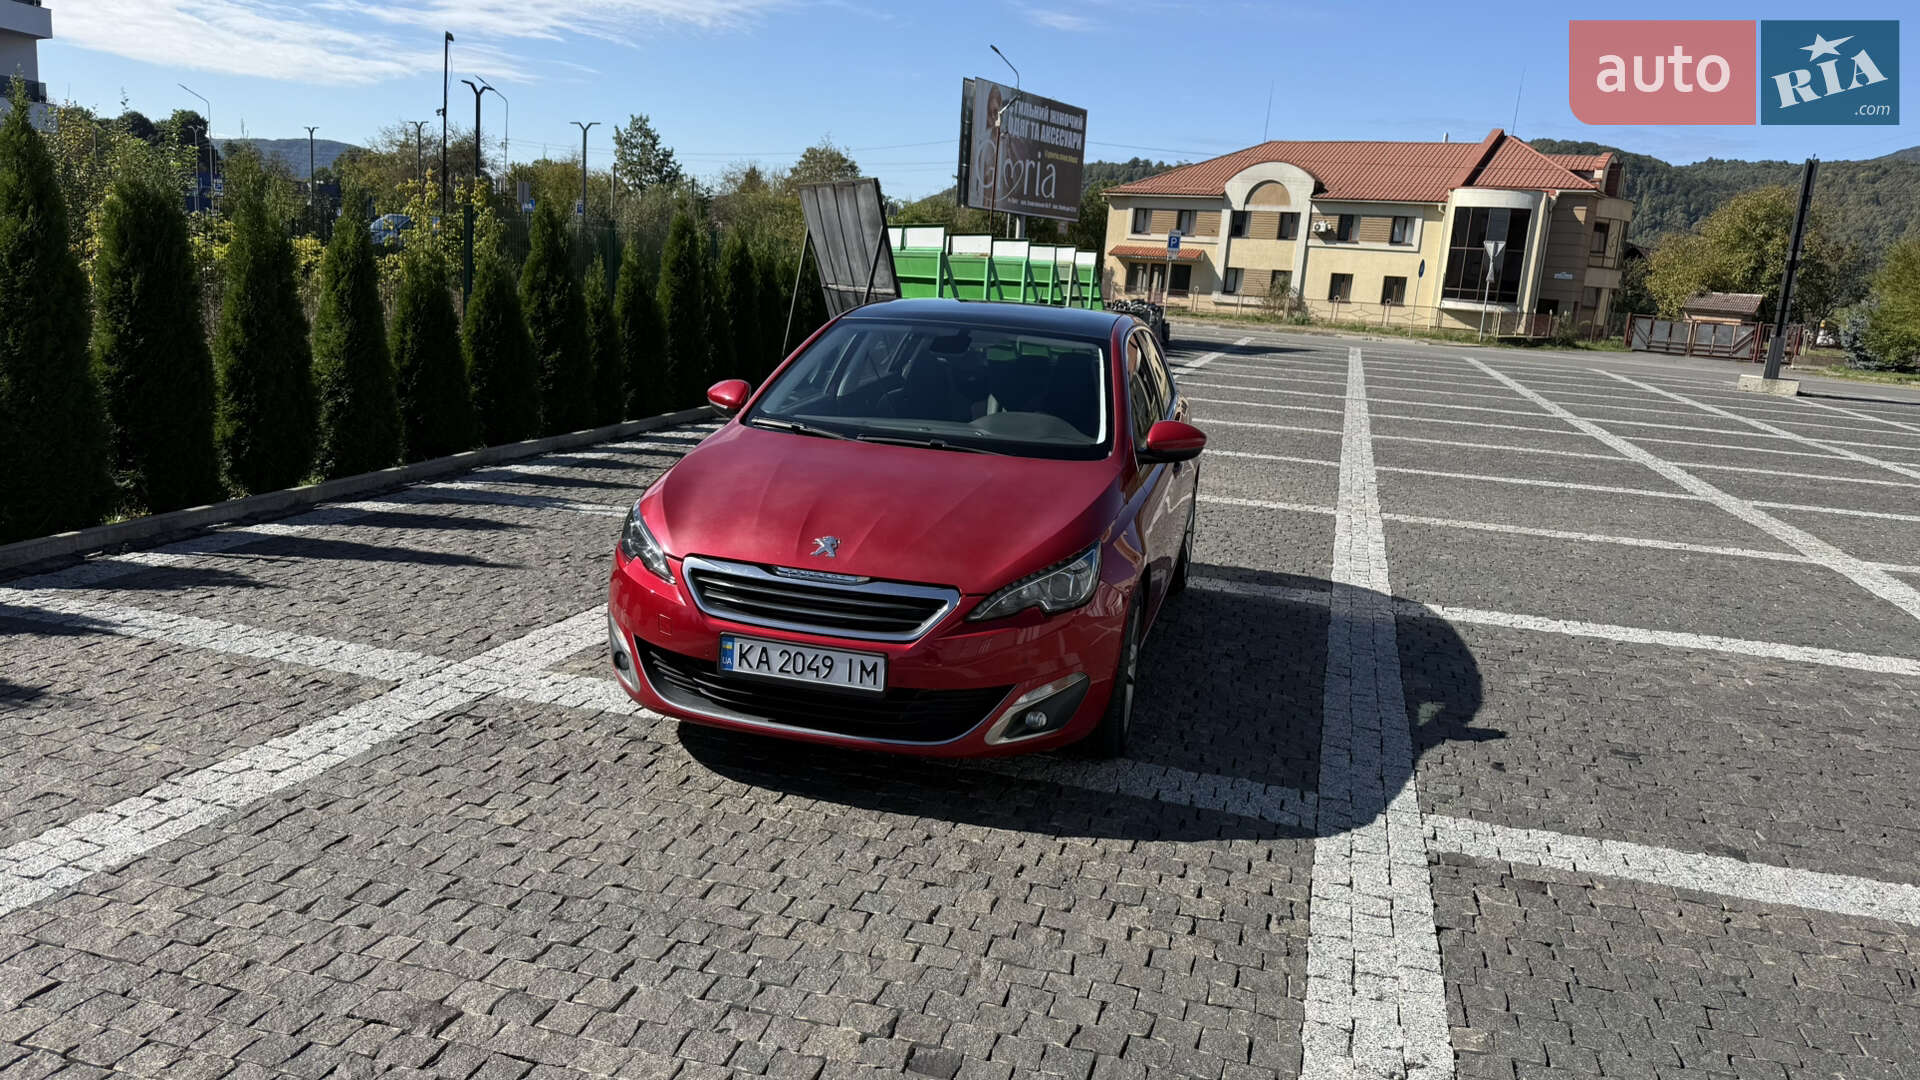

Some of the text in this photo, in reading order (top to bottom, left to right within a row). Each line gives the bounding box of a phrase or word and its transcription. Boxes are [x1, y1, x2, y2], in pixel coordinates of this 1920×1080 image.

[1030, 121, 1040, 140] ТА
[1040, 124, 1082, 151] АКСЕСУАРИ
[722, 643, 878, 686] UA KA 2049 IM
